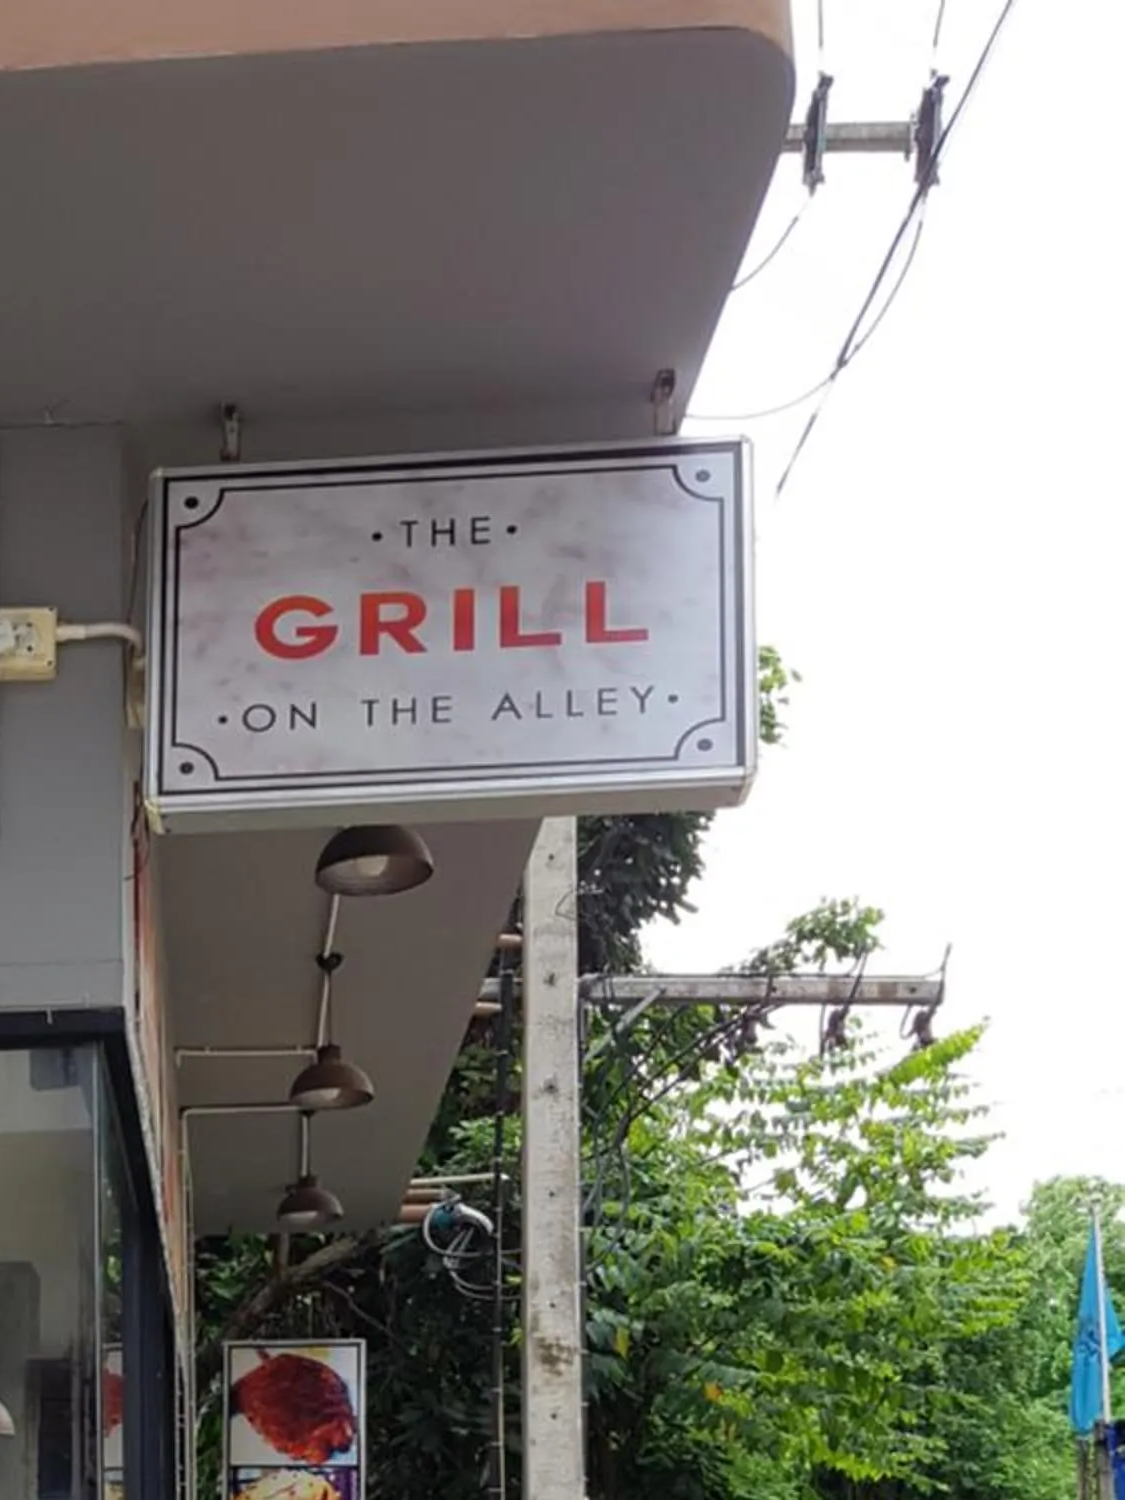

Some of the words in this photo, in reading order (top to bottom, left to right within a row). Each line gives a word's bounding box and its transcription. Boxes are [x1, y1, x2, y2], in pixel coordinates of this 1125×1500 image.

[400, 517, 492, 547] THE
[254, 581, 649, 660] GRILL
[242, 702, 318, 732] ON
[361, 696, 452, 726] THE
[491, 686, 656, 721] ALLEY
